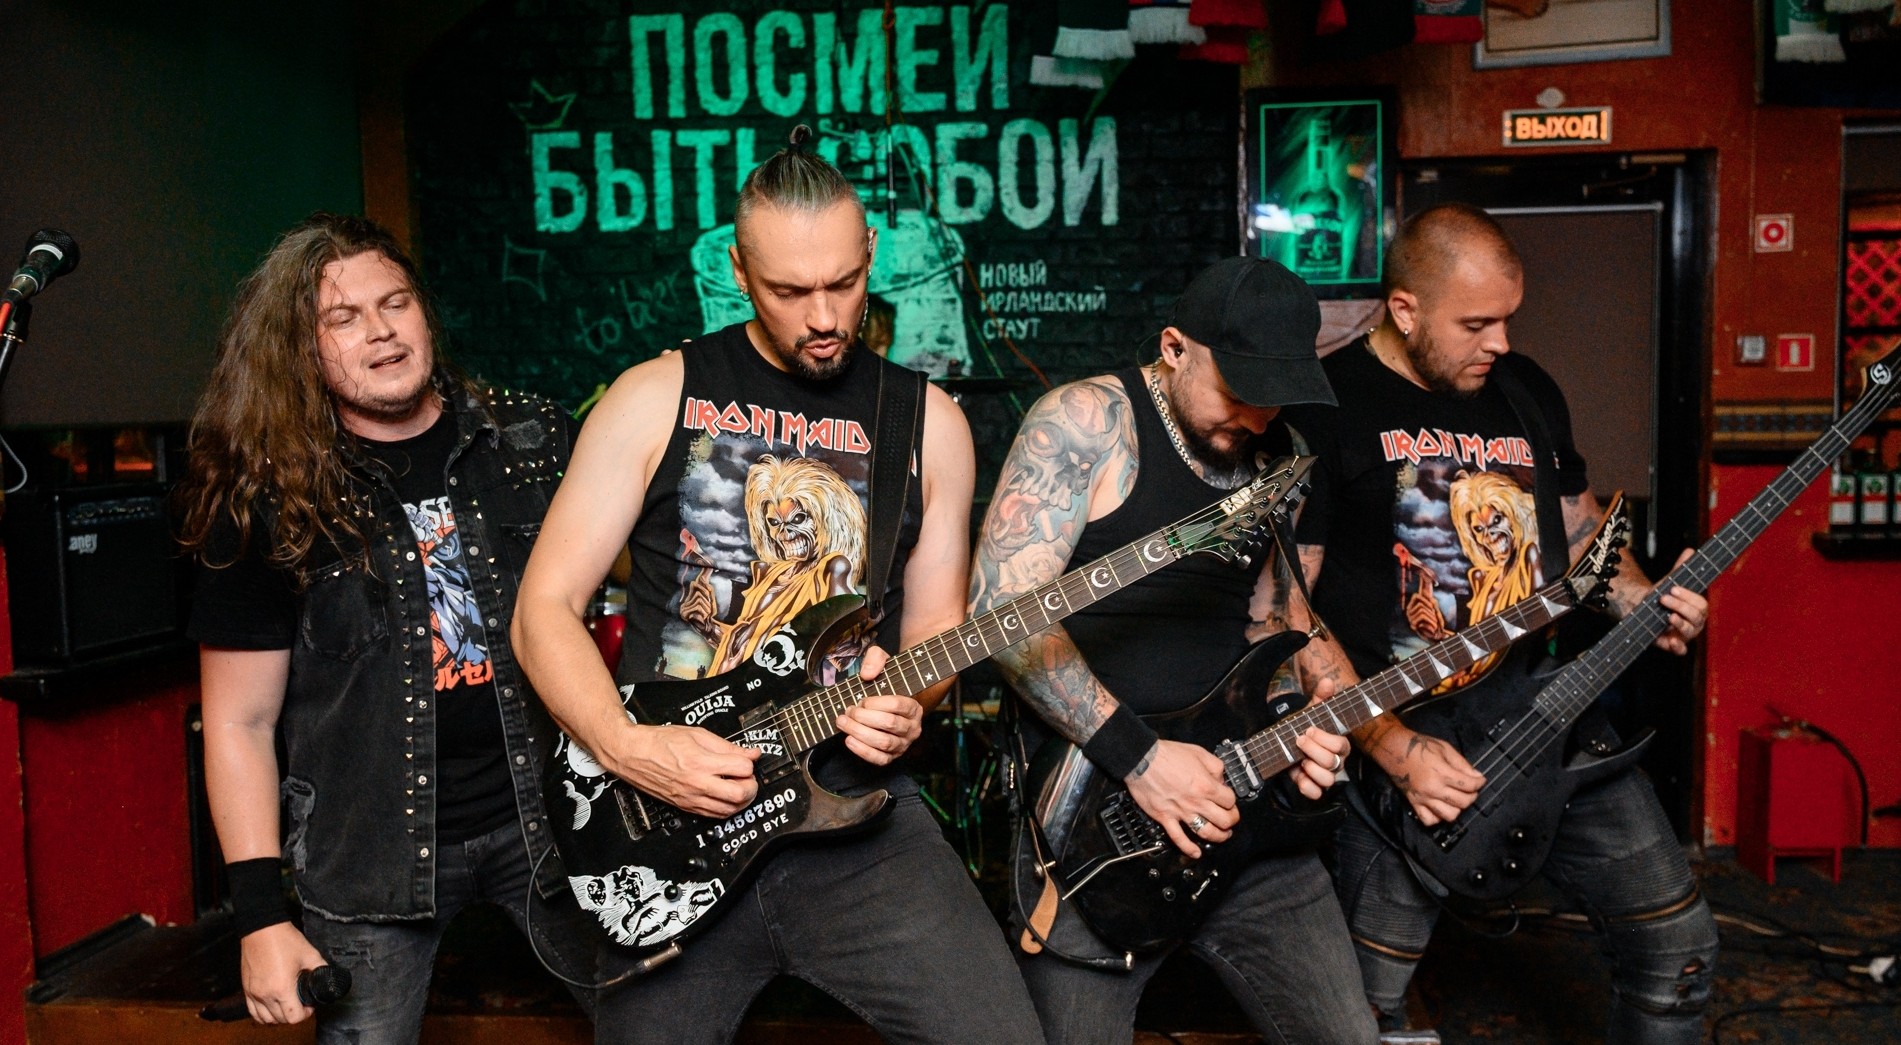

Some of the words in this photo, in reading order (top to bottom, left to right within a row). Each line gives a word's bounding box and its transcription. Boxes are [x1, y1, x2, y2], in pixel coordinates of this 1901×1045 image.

[1516, 114, 1598, 139] ВЫХОД
[980, 259, 1047, 288] НОВЫЙ
[980, 285, 1106, 312] ИРЛАНДСКИЙ
[982, 317, 1041, 340] СТАУТ
[684, 396, 775, 451] IRON
[1380, 426, 1463, 467] IRON
[1588, 514, 1616, 574] Jackson
[746, 678, 762, 691] NO
[685, 695, 735, 725] OUIJA
[696, 788, 796, 848] 134567890
[722, 829, 758, 853] GOOD
[762, 813, 789, 833] BYE
